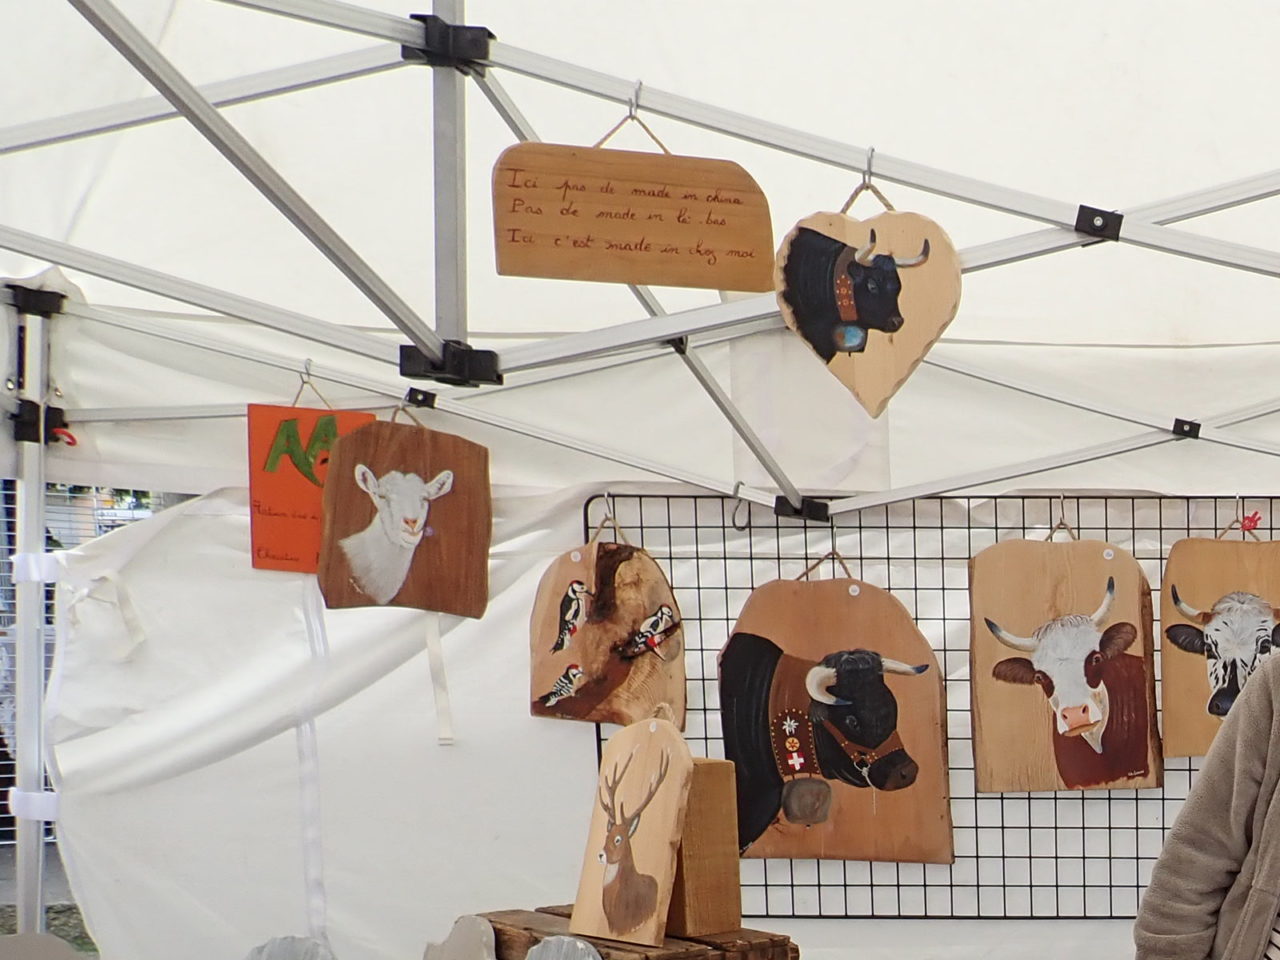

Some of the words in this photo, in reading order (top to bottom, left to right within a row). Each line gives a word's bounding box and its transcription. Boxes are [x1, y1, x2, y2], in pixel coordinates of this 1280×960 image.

[506, 168, 538, 188] Ici
[555, 180, 586, 201] pas
[600, 182, 615, 194] de
[631, 180, 671, 198] made
[682, 189, 698, 200] in
[509, 198, 543, 215] Pas
[560, 201, 579, 217] de
[596, 208, 637, 220] made
[648, 213, 664, 222] in
[507, 229, 535, 243] Ici
[554, 235, 594, 248] c'est
[606, 236, 652, 252] made
[661, 243, 680, 255] in
[727, 247, 756, 258] moi
